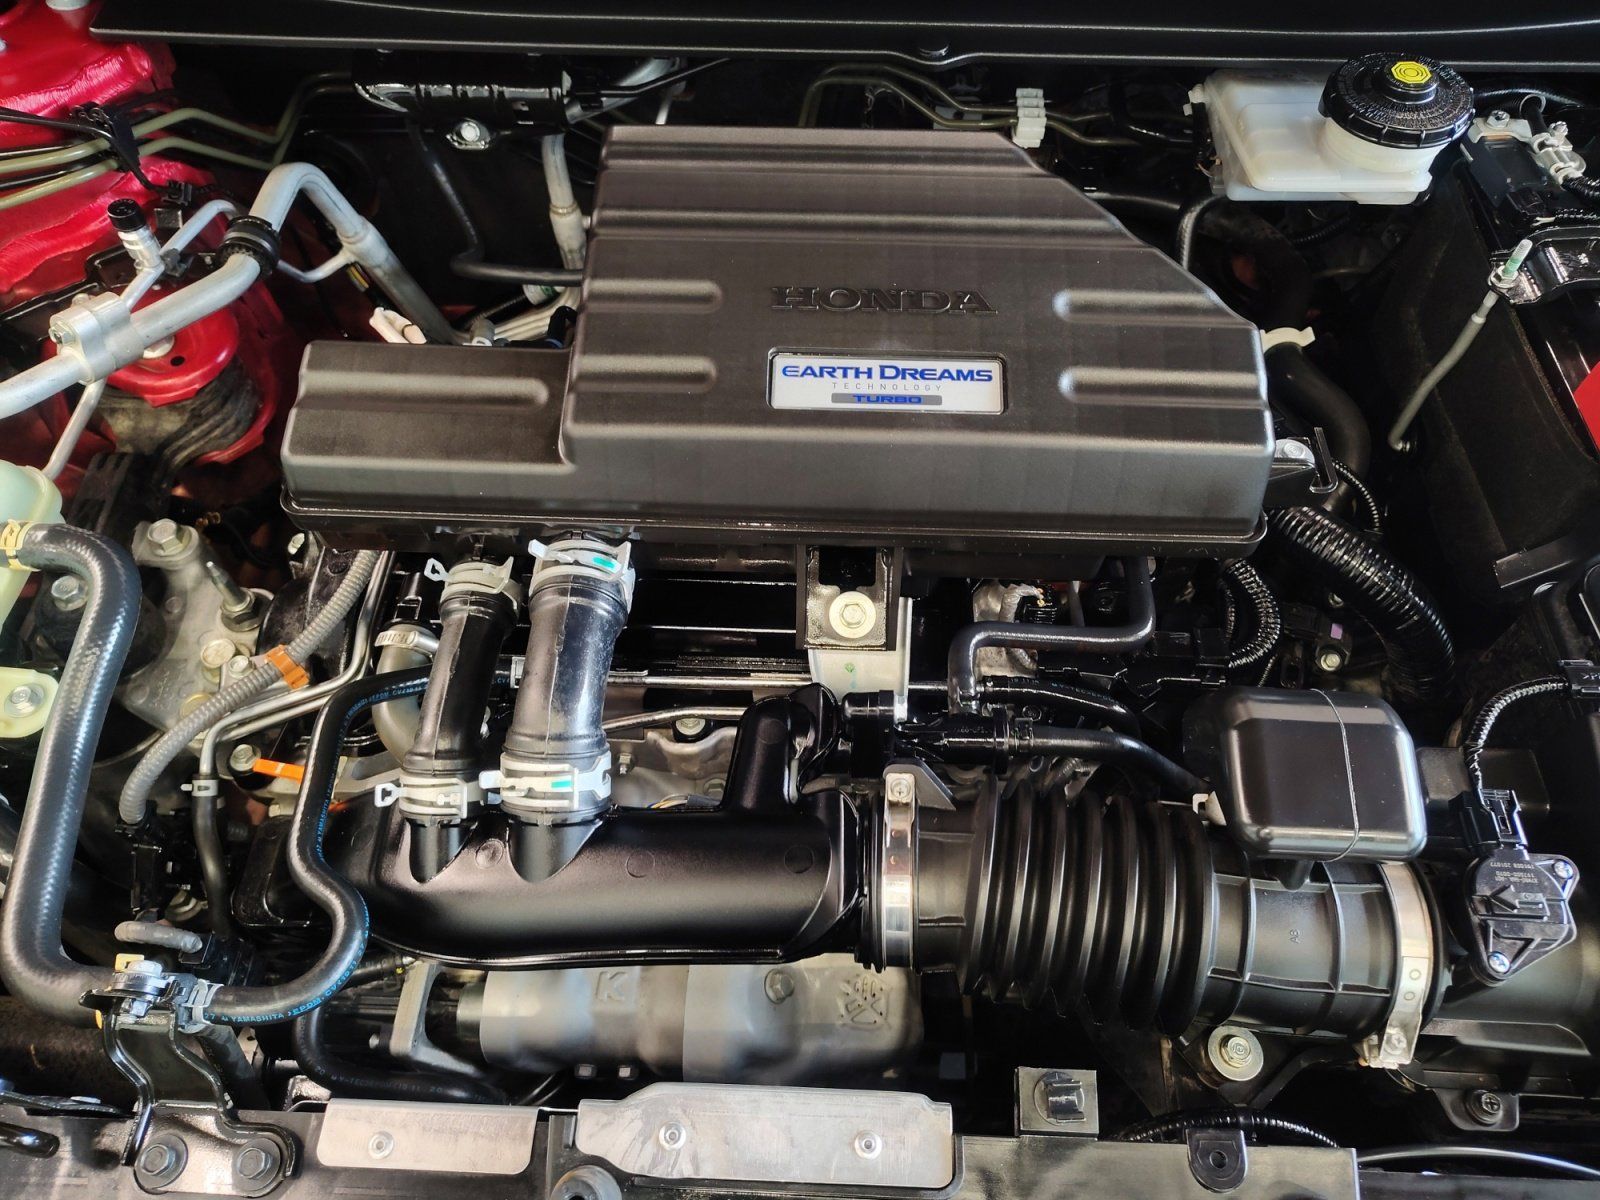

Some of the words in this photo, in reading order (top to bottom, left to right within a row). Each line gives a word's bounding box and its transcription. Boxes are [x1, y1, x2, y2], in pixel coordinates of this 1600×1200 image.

[771, 287, 999, 314] HONDA
[782, 365, 873, 380] EARTH
[879, 364, 993, 382] DREAMS
[832, 382, 943, 392] TECHNOLOGY
[853, 394, 923, 405] TURBO
[231, 1012, 285, 1022] YAMASHITA
